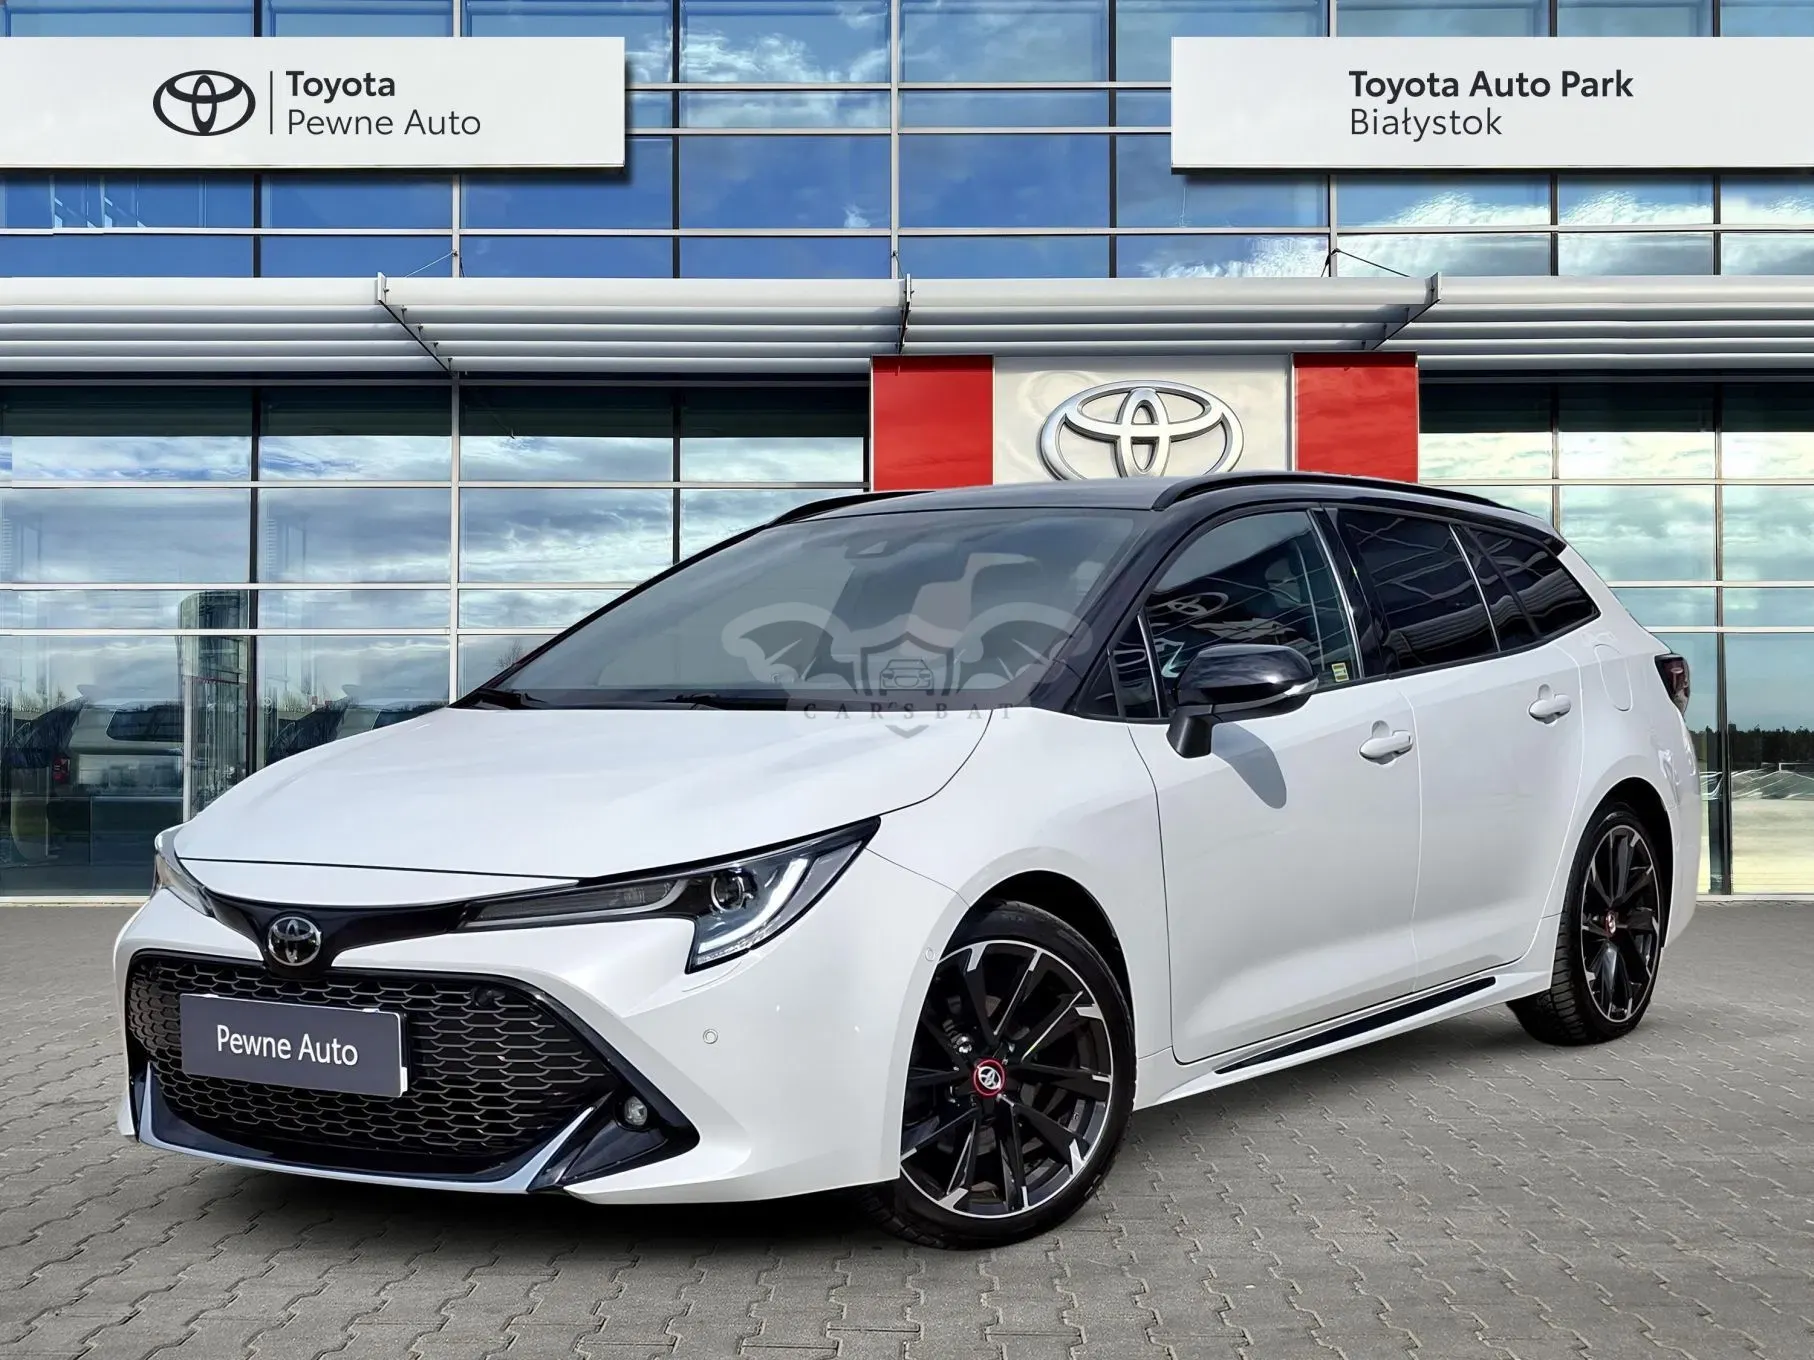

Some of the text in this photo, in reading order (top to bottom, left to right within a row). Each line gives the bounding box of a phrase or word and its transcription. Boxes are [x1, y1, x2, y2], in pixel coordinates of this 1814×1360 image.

[286, 71, 395, 103] Toyota
[1349, 70, 1633, 104] Toyota Auto Park
[289, 109, 480, 135] Pewne Auto
[1352, 107, 1502, 142] Białystok
[218, 1025, 358, 1065] Pewne Auto
